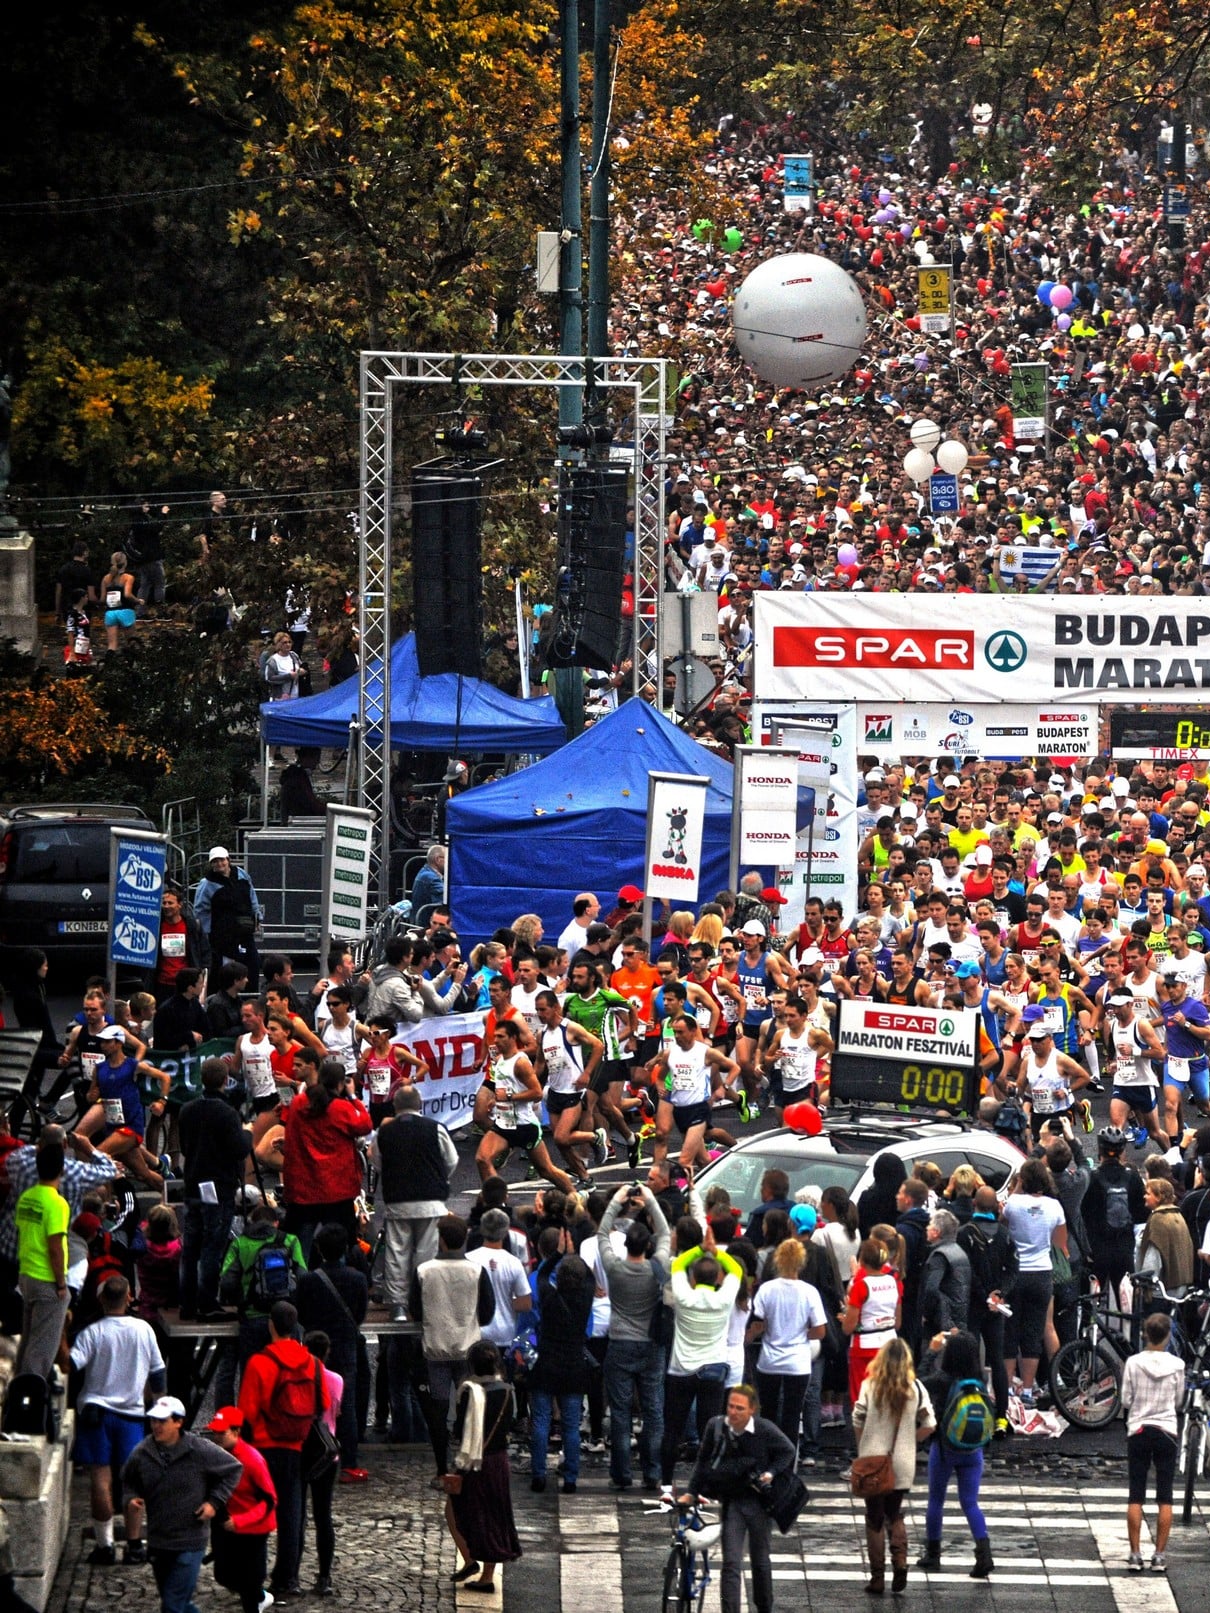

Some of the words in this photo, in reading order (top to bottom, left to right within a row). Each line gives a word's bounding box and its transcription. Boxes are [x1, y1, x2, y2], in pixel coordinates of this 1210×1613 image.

[929, 274, 938, 285] 3
[932, 485, 955, 495] 3:30
[814, 636, 970, 665] SPAR
[957, 714, 969, 725] BSI
[903, 730, 927, 738] MOB
[1036, 727, 1089, 738] BUDAPEST
[799, 754, 821, 762] PAR
[1149, 748, 1198, 760] TIMEX
[338, 826, 367, 841] metropol
[825, 831, 836, 840] BSI
[119, 842, 142, 851] MOZOGJ
[336, 846, 365, 861] metropol
[135, 866, 154, 889] BSI
[334, 869, 363, 884] metropol
[117, 891, 159, 902] www.futanet.hu
[333, 893, 362, 908] metropol
[115, 904, 138, 914] MOZOGJ
[332, 915, 360, 930] metropol
[130, 929, 149, 952] BSI
[112, 952, 153, 965] www.futanet.hu
[878, 1015, 936, 1032] SPAR
[840, 1031, 903, 1051] MARATON
[906, 1037, 973, 1058] FESZTIVÁL
[391, 1033, 492, 1083] OND
[901, 1065, 965, 1105] 0:00
[431, 1096, 446, 1114] of
[450, 1091, 477, 1112] Dre
